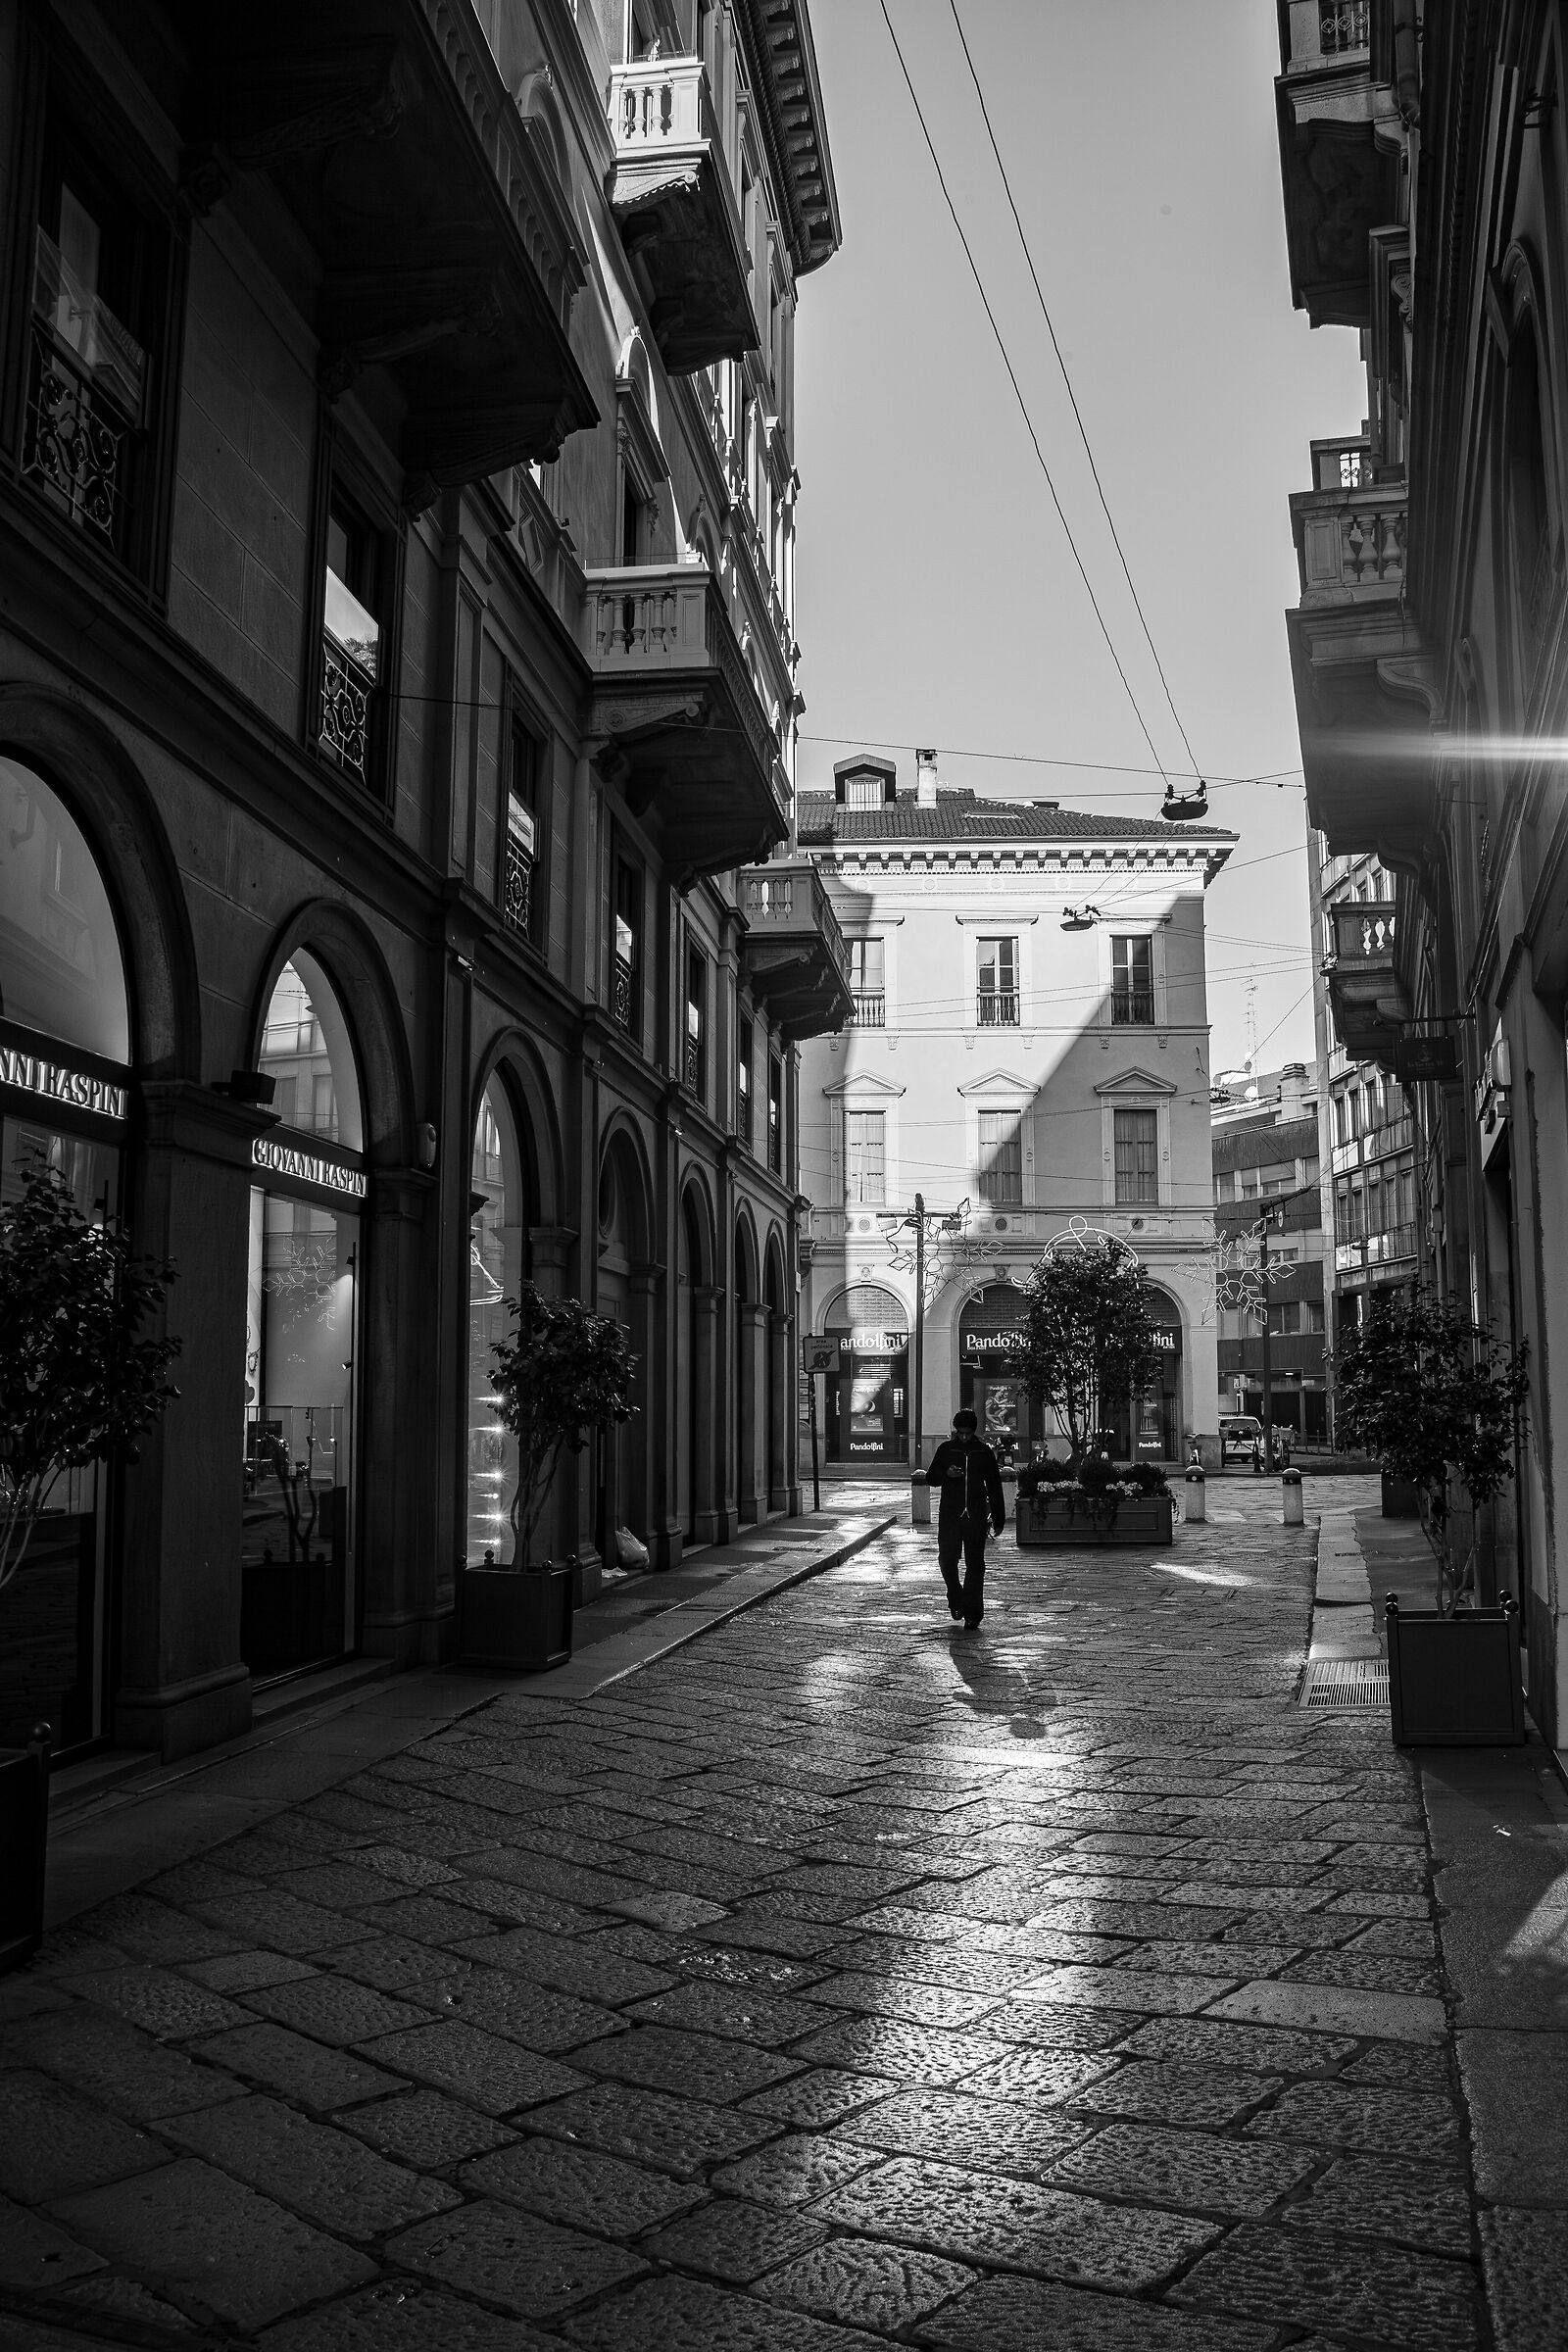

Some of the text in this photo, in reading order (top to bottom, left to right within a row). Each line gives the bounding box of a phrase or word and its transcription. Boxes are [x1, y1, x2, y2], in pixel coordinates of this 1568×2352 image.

[37, 1061, 128, 1120] RASPINI
[252, 1138, 368, 1198] GIOVANNI RASPINI
[840, 1333, 902, 1350] andolfini
[850, 1443, 884, 1451] Pandolfini
